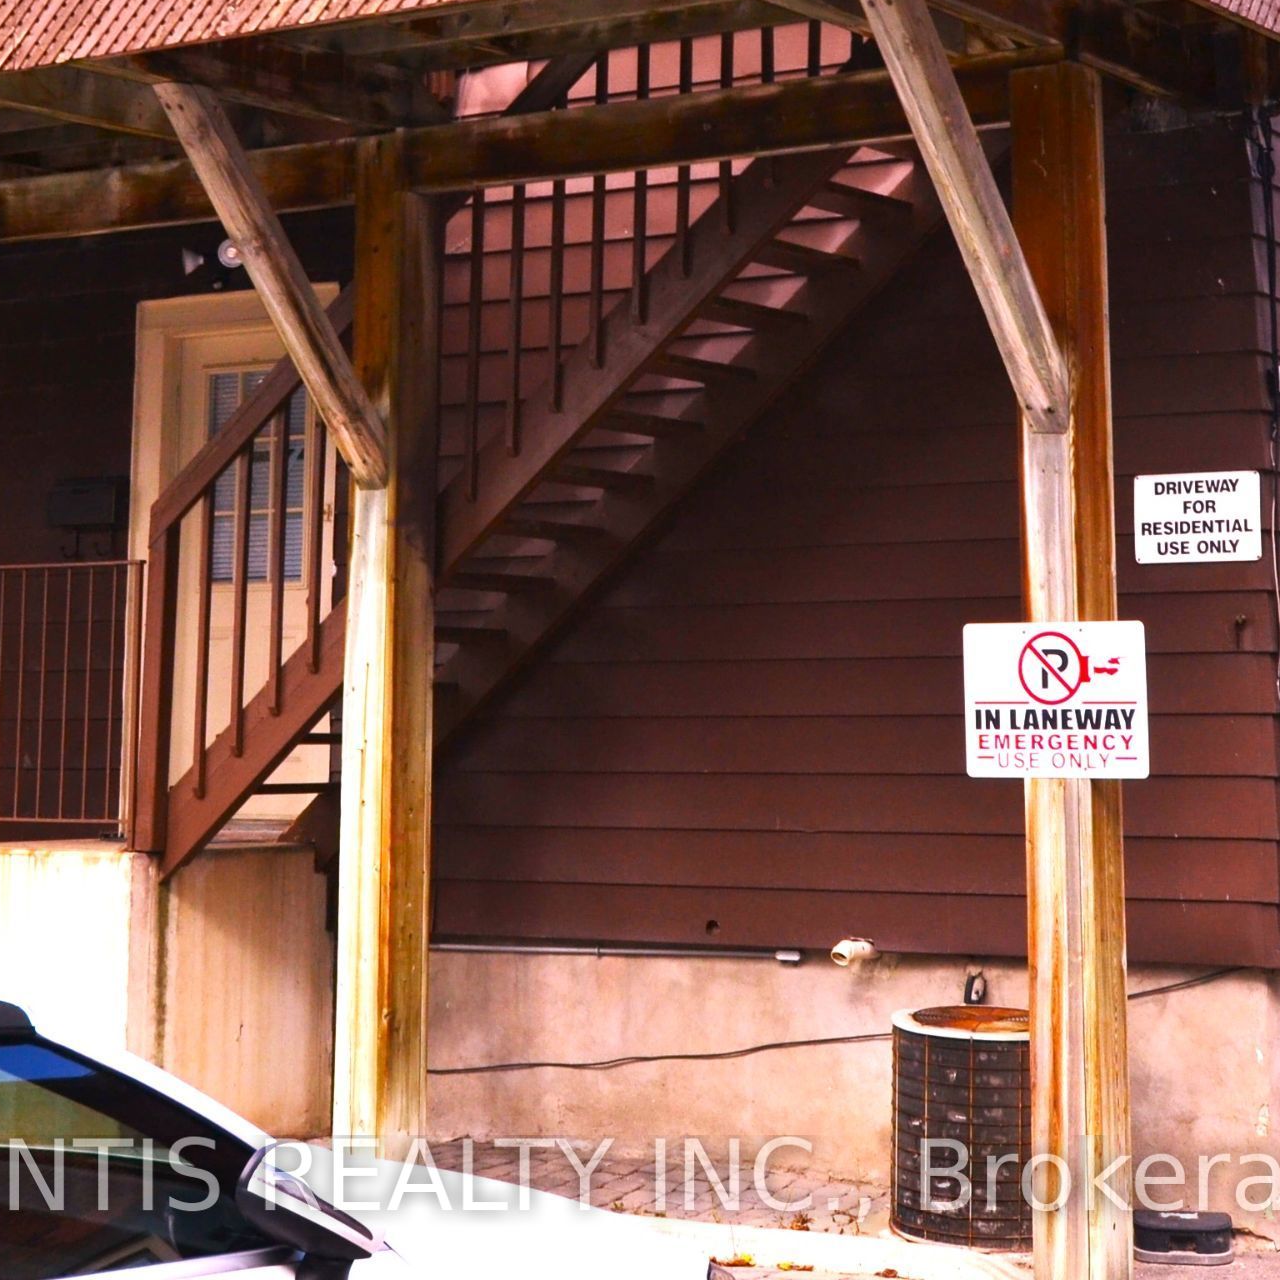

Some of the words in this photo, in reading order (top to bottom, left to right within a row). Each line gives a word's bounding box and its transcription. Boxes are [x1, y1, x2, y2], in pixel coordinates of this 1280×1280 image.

[1154, 478, 1239, 496] DRIVEWAY
[1183, 499, 1216, 514] FOR
[1141, 518, 1253, 536] RESIDENTIAL
[1157, 541, 1190, 556] USE
[1197, 539, 1239, 554] ONLY
[975, 709, 1001, 730] IN
[1010, 708, 1135, 730] LANEWAY
[978, 734, 1133, 750] EMERGENCY
[998, 753, 1040, 769] USE
[1051, 752, 1109, 769] ONLY
